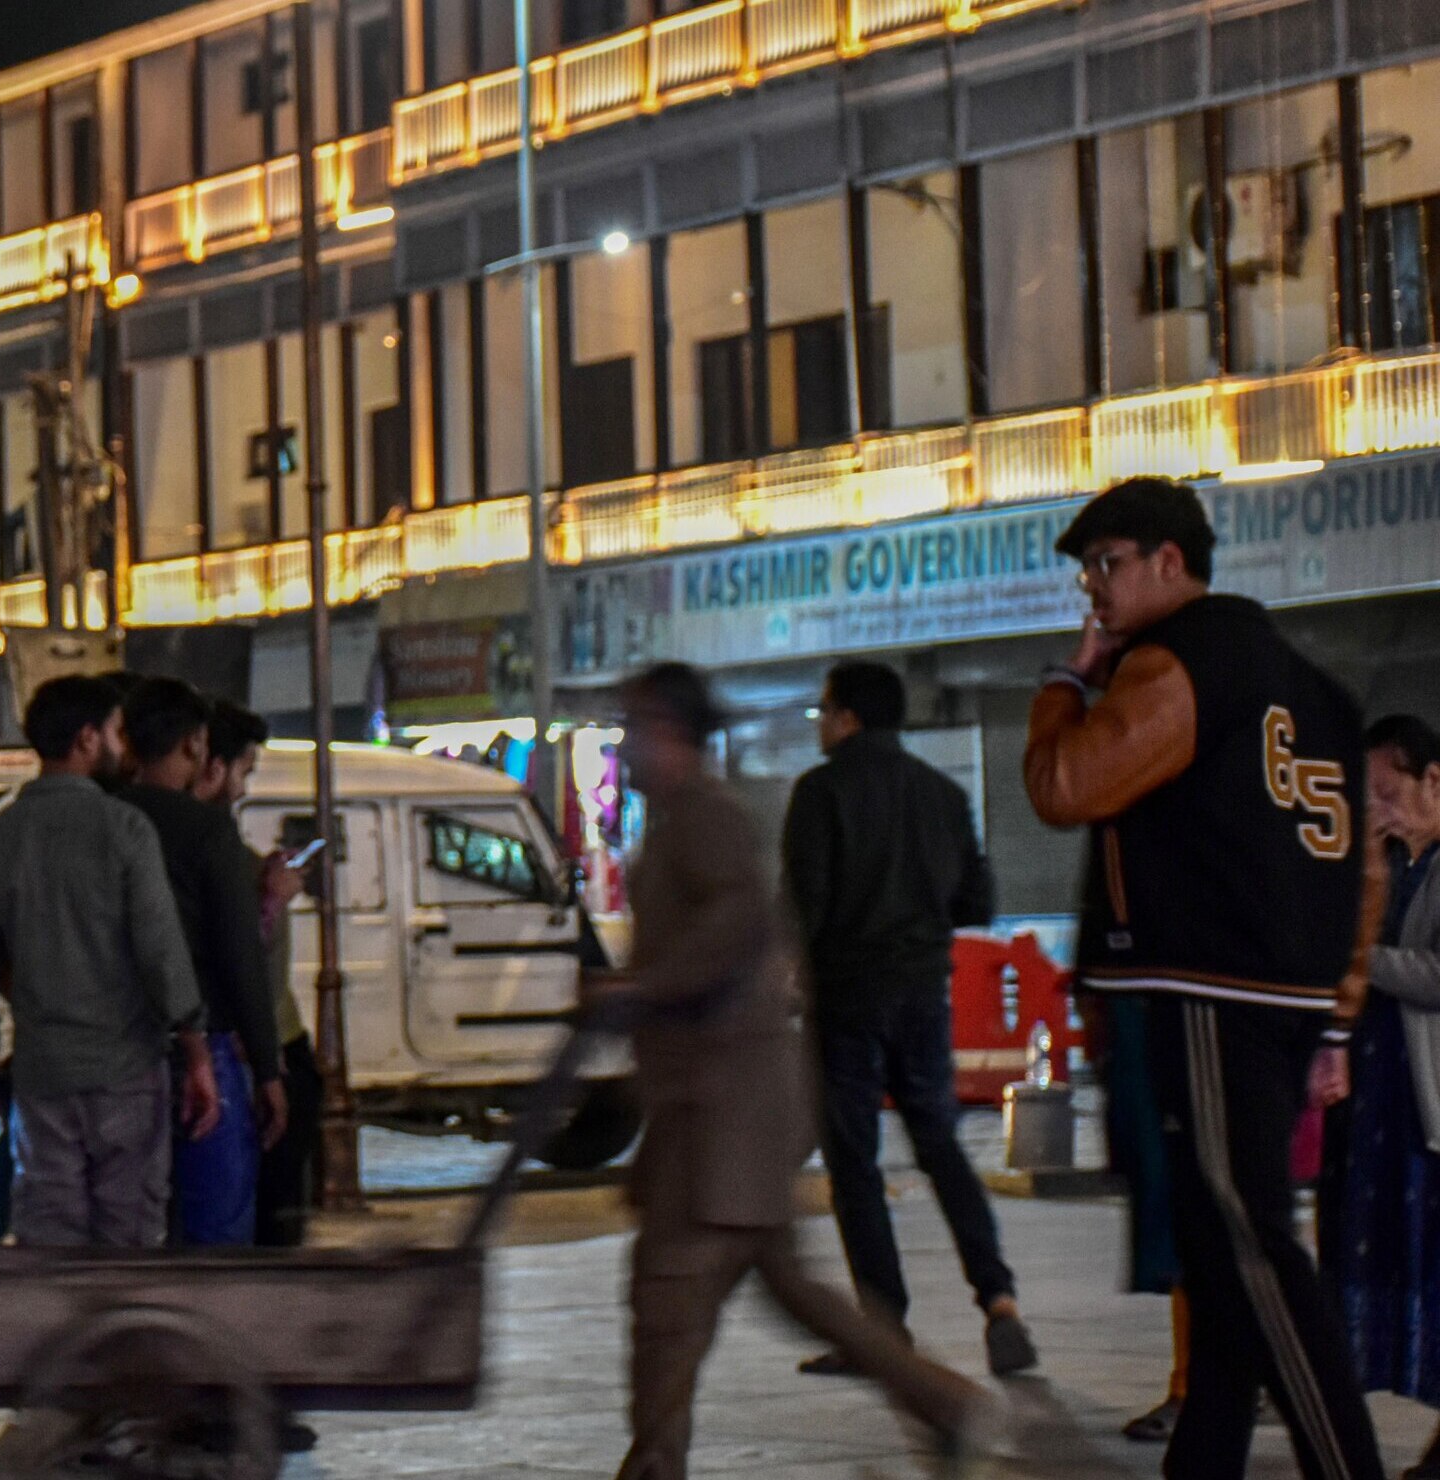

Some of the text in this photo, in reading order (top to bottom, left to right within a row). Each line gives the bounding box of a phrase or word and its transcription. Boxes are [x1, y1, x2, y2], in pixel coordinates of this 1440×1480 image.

[683, 543, 830, 613] KASHMIR
[846, 511, 1074, 592] GOVERNMEN
[1213, 461, 1440, 546] EMPORIUM
[1263, 705, 1351, 858] 65
